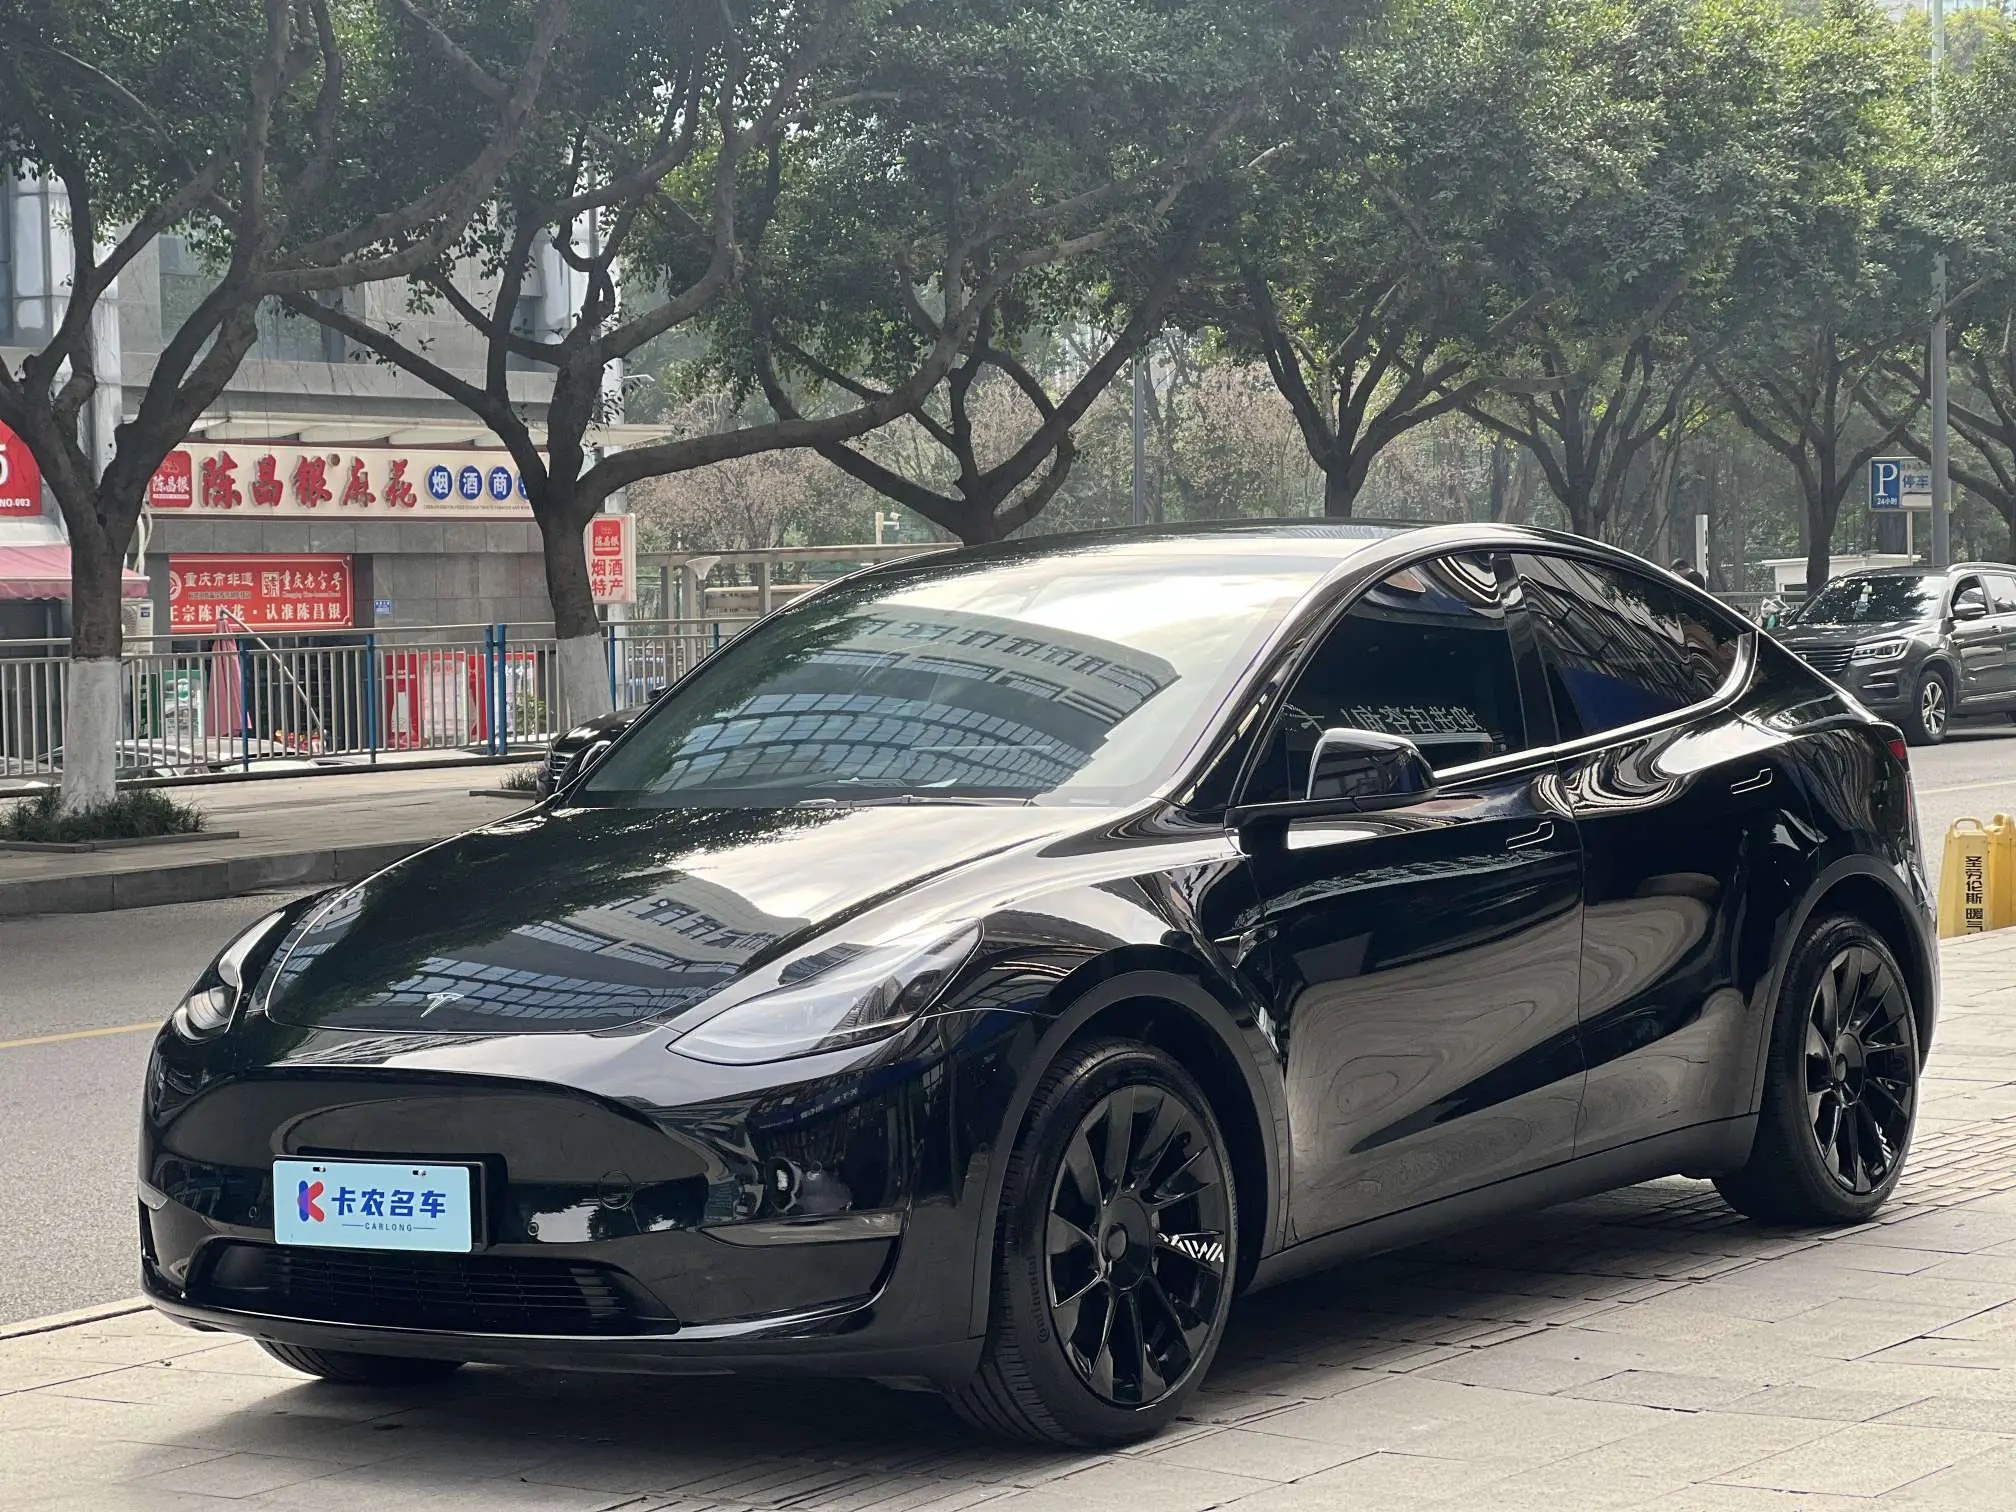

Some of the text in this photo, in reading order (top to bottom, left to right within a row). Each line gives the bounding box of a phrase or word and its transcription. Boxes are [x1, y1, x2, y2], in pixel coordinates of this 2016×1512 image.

[199, 450, 417, 509] 陈昌银麻花
[1875, 463, 1898, 496] P
[591, 559, 623, 577] 烟酒
[591, 578, 623, 597] 特产
[1965, 855, 1983, 904] 圣劳伦斯
[331, 1186, 446, 1218] 卡农名车
[364, 1222, 412, 1232] CARLONG
